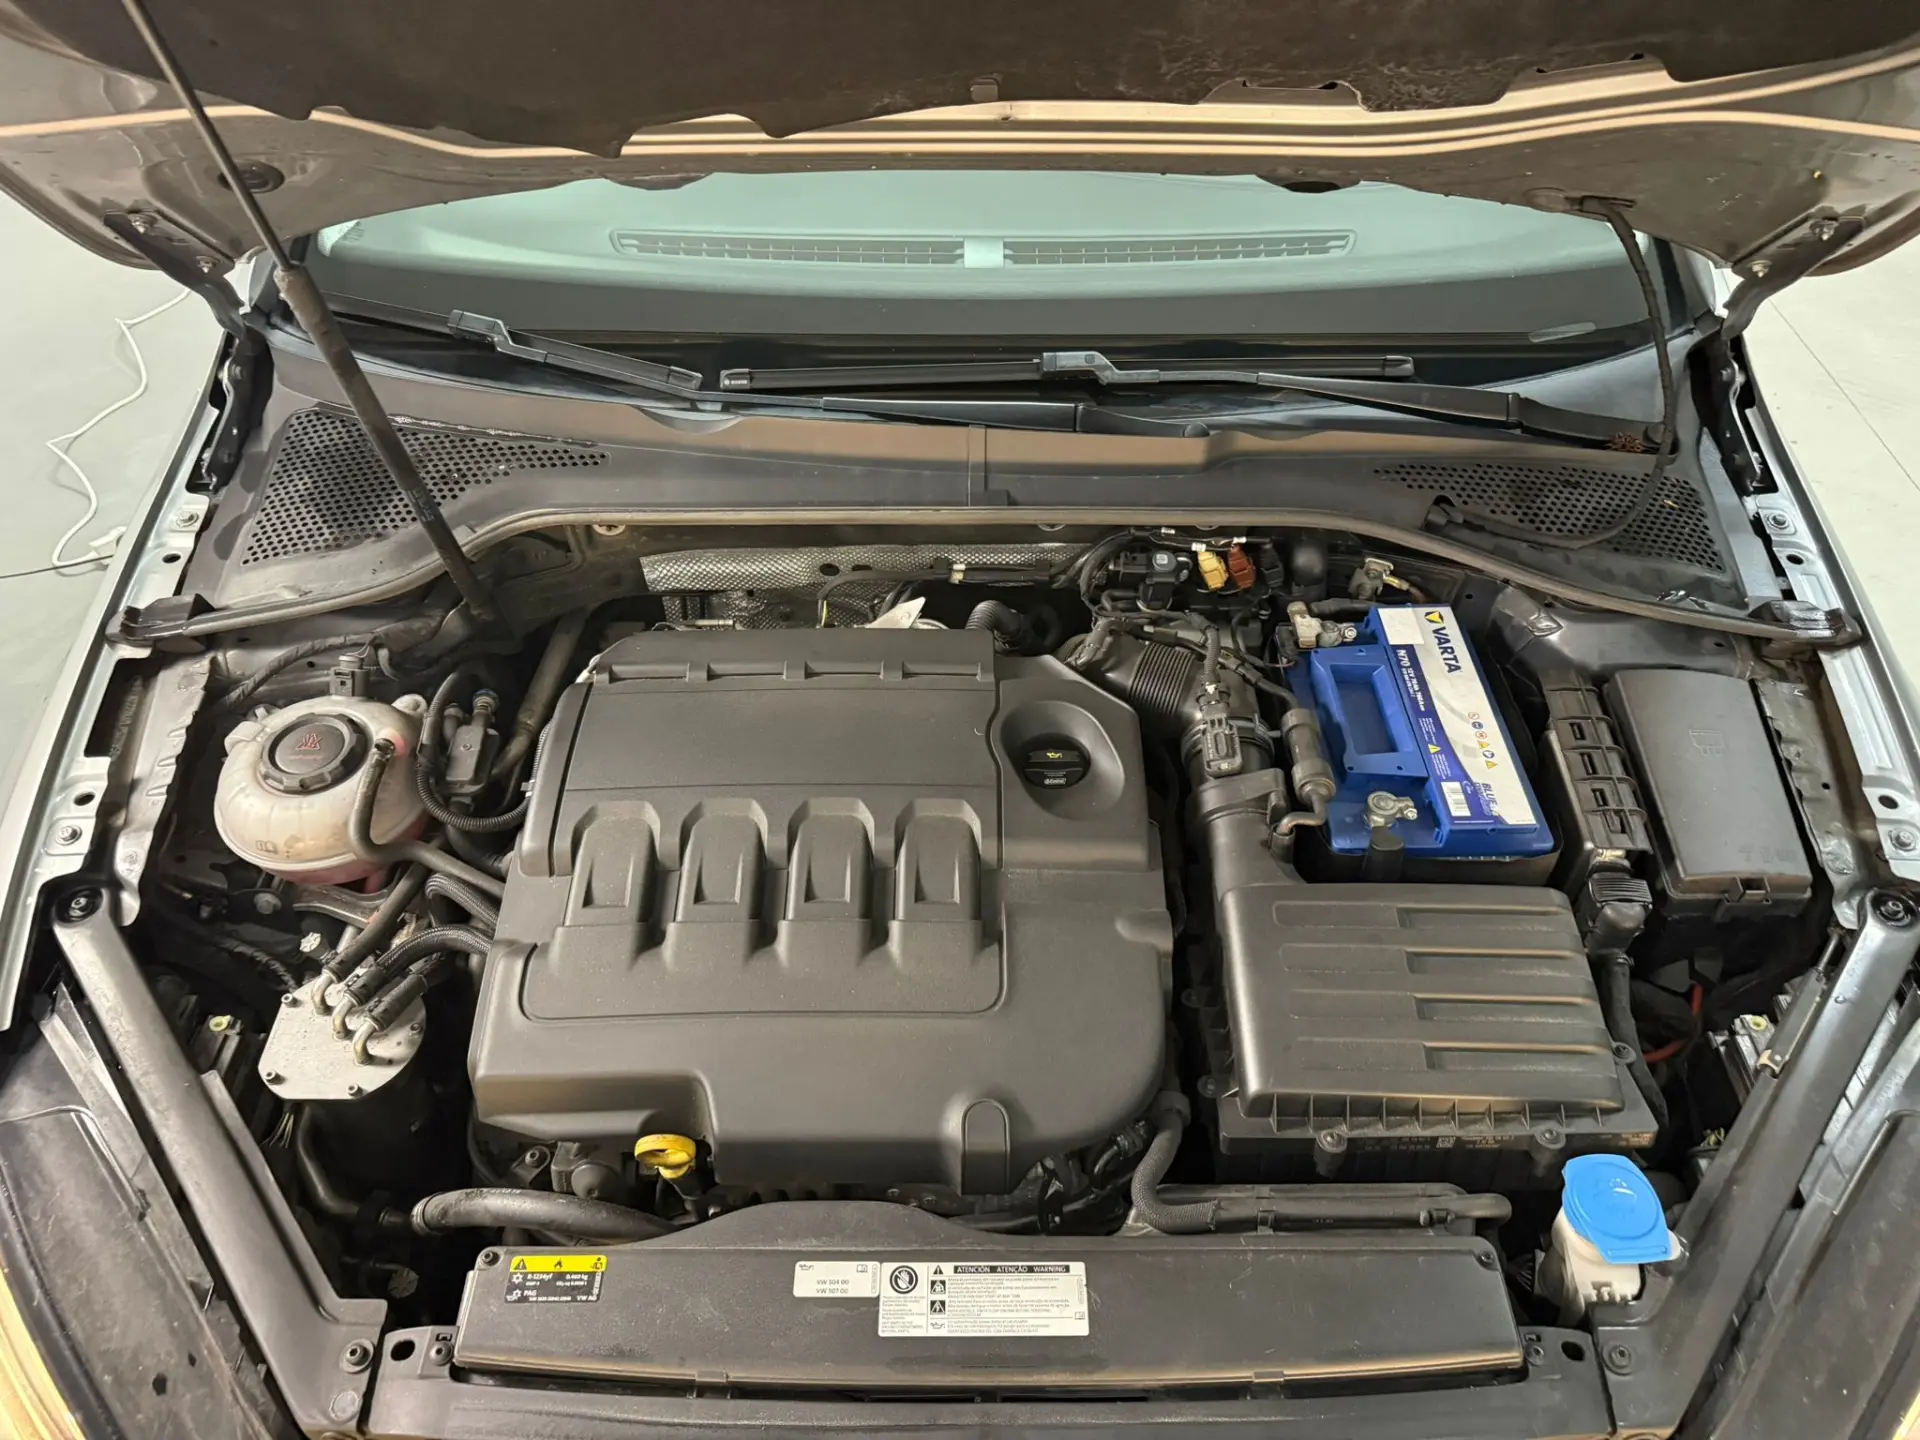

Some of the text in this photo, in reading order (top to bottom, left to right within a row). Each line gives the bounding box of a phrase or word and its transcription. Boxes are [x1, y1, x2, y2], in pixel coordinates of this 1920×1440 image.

[1396, 649, 1411, 667] N70
[1432, 626, 1462, 673] VARTA
[1033, 1265, 1066, 1273] WARNING
